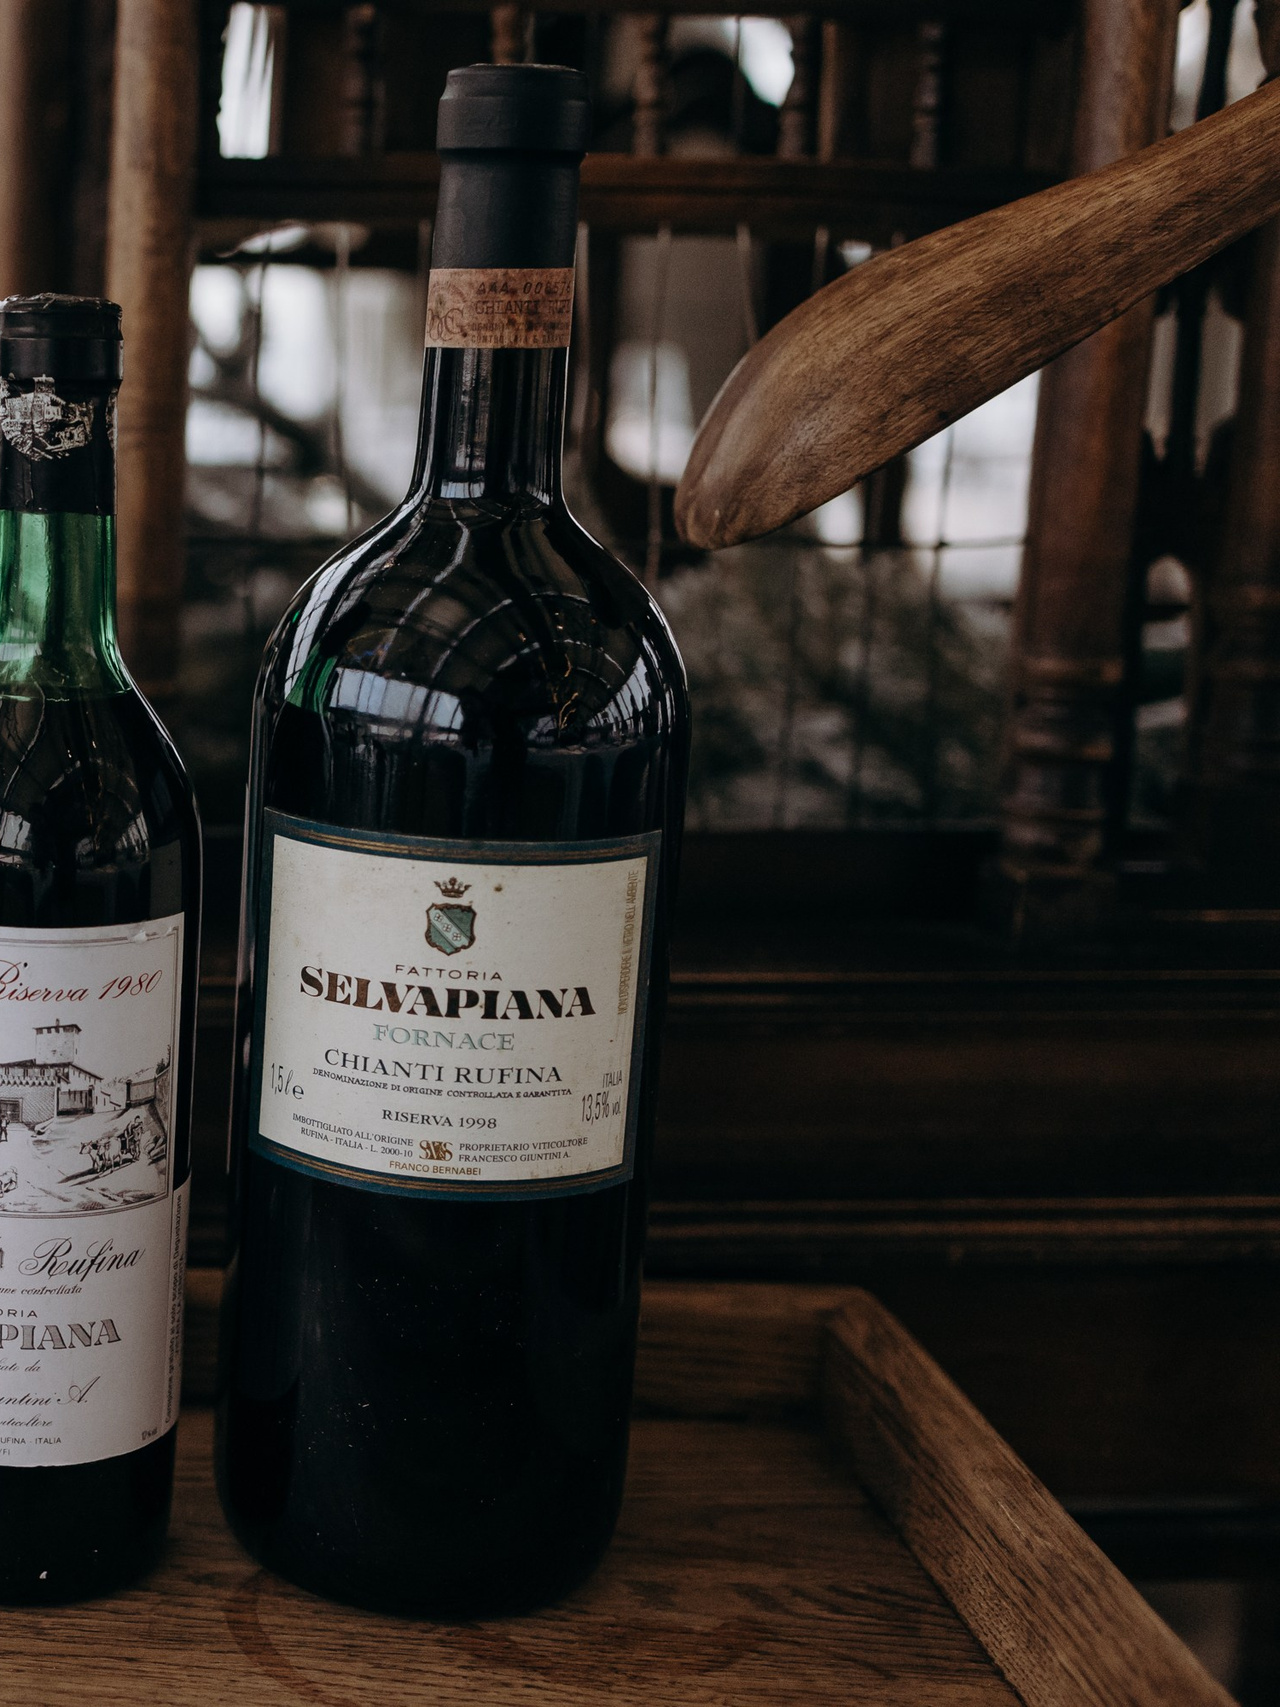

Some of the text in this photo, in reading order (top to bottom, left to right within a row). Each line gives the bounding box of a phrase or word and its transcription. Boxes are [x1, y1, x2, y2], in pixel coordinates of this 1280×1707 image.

[97, 969, 163, 1001] 1980
[395, 964, 503, 982] FATTORIA
[299, 965, 596, 1020] SELVAPIANA
[372, 1023, 515, 1051] FORNACE
[324, 1048, 562, 1085] CHIANTI RUFINA
[313, 1068, 388, 1090] DENOMINAZIONE
[403, 1086, 443, 1096] ORIGINE
[447, 1090, 513, 1099] CONTROLLATA
[523, 1088, 572, 1098] GARANTITA
[602, 1070, 623, 1089] ITALIA
[382, 1109, 497, 1130] RISERVA 1998
[581, 1090, 610, 1126] 13,5%
[292, 1113, 414, 1147] IMBOTTIGLIATO ALL'ORIGINE
[301, 1127, 329, 1143] RUFINA
[335, 1138, 364, 1151] ITALIA
[380, 1147, 413, 1158] 2000-10
[459, 1137, 588, 1152] PROPRIETARIO VITICOLTORE
[389, 1160, 481, 1176] FRANCO BERNABEI
[459, 1154, 518, 1163] FRANCESCO
[520, 1152, 562, 1162] GIUNTINI
[17, 1237, 146, 1283] Rufina
[20, 1282, 83, 1297] controllata
[24, 1359, 41, 1373] da
[35, 1437, 62, 1445] ITALIA
